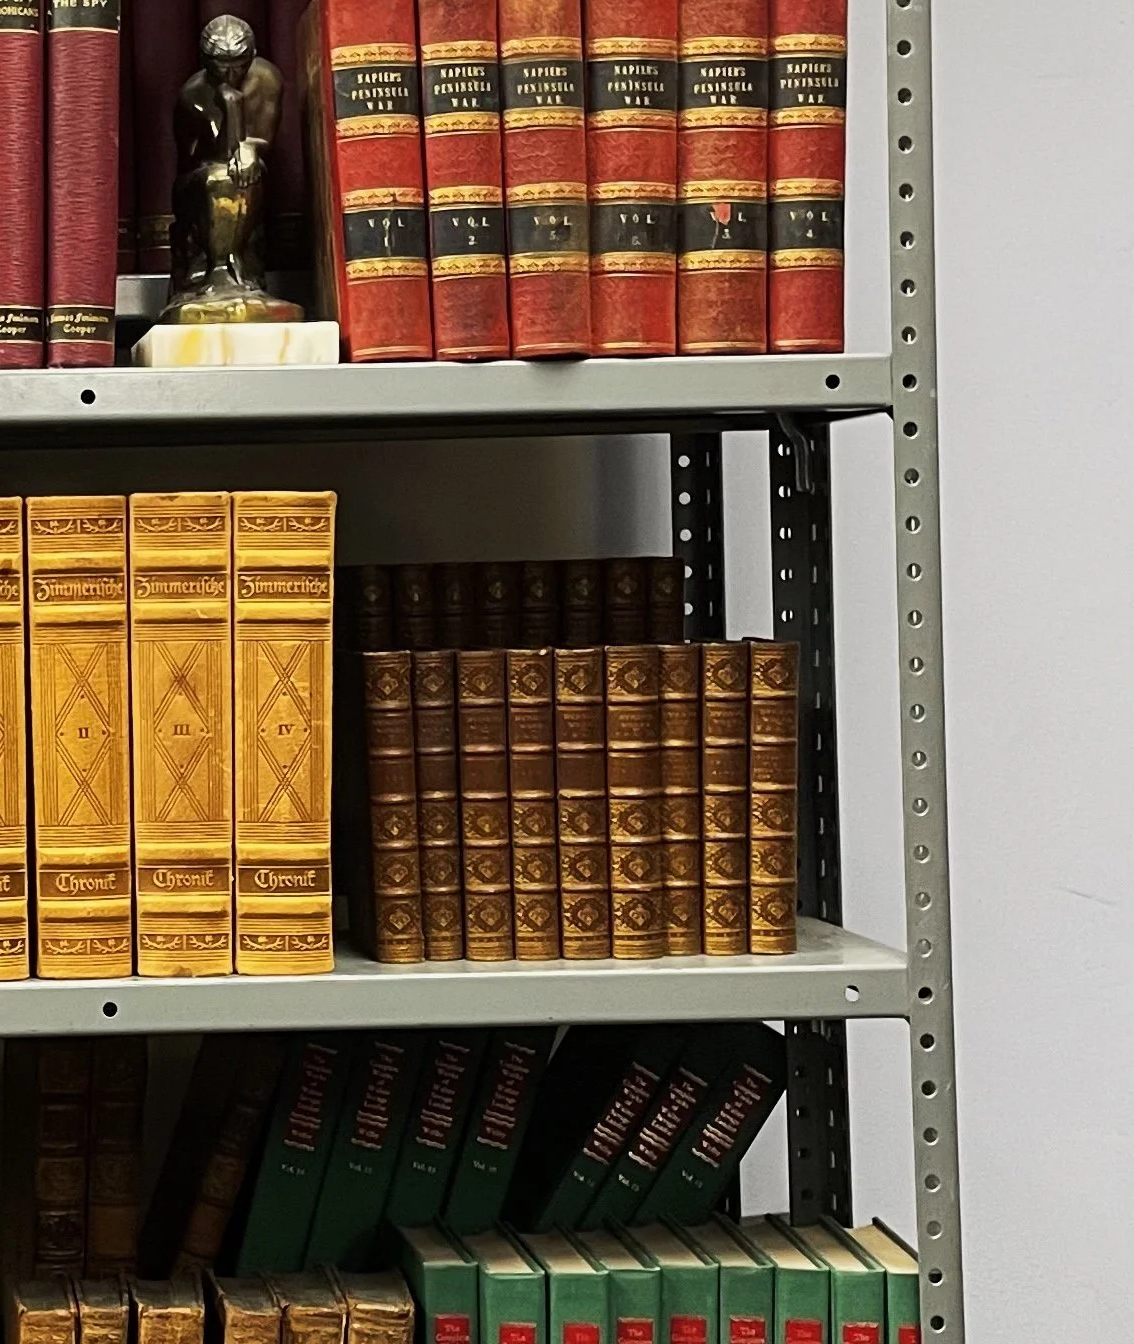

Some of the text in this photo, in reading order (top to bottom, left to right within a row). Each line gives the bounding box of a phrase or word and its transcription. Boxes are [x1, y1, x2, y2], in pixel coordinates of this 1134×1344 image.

[450, 97, 480, 109] WAR
[535, 94, 564, 107] WAR
[624, 95, 653, 107] WAR
[710, 94, 739, 106] WAR
[797, 92, 827, 105] WAR
[366, 100, 395, 111] WAR
[78, 727, 90, 740] II
[173, 724, 190, 737] III
[278, 723, 296, 736] IV
[55, 872, 117, 893] Chronik
[152, 868, 215, 891] Chronik
[253, 868, 317, 891] Chronik
